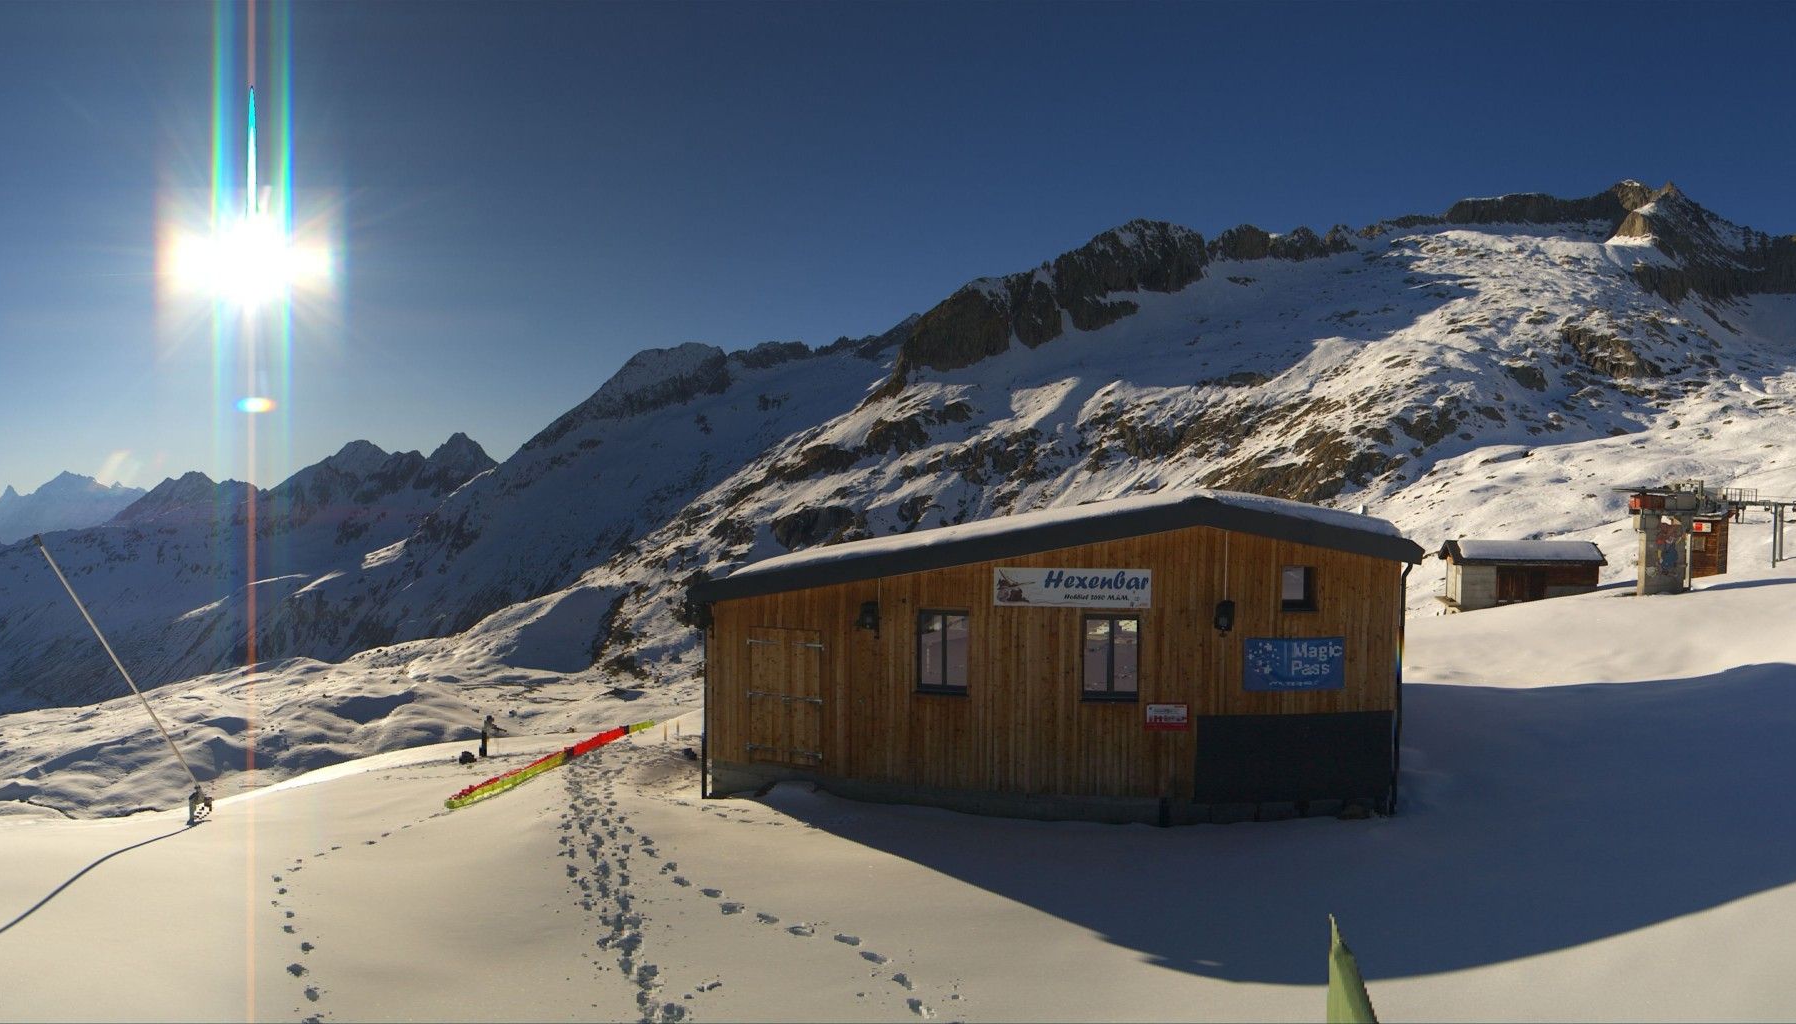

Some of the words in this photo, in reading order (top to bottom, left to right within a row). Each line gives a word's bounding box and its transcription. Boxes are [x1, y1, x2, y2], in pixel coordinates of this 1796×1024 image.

[1044, 570, 1149, 590] Hexenbar
[1292, 641, 1343, 661] Magic
[1291, 660, 1330, 676] Pass
